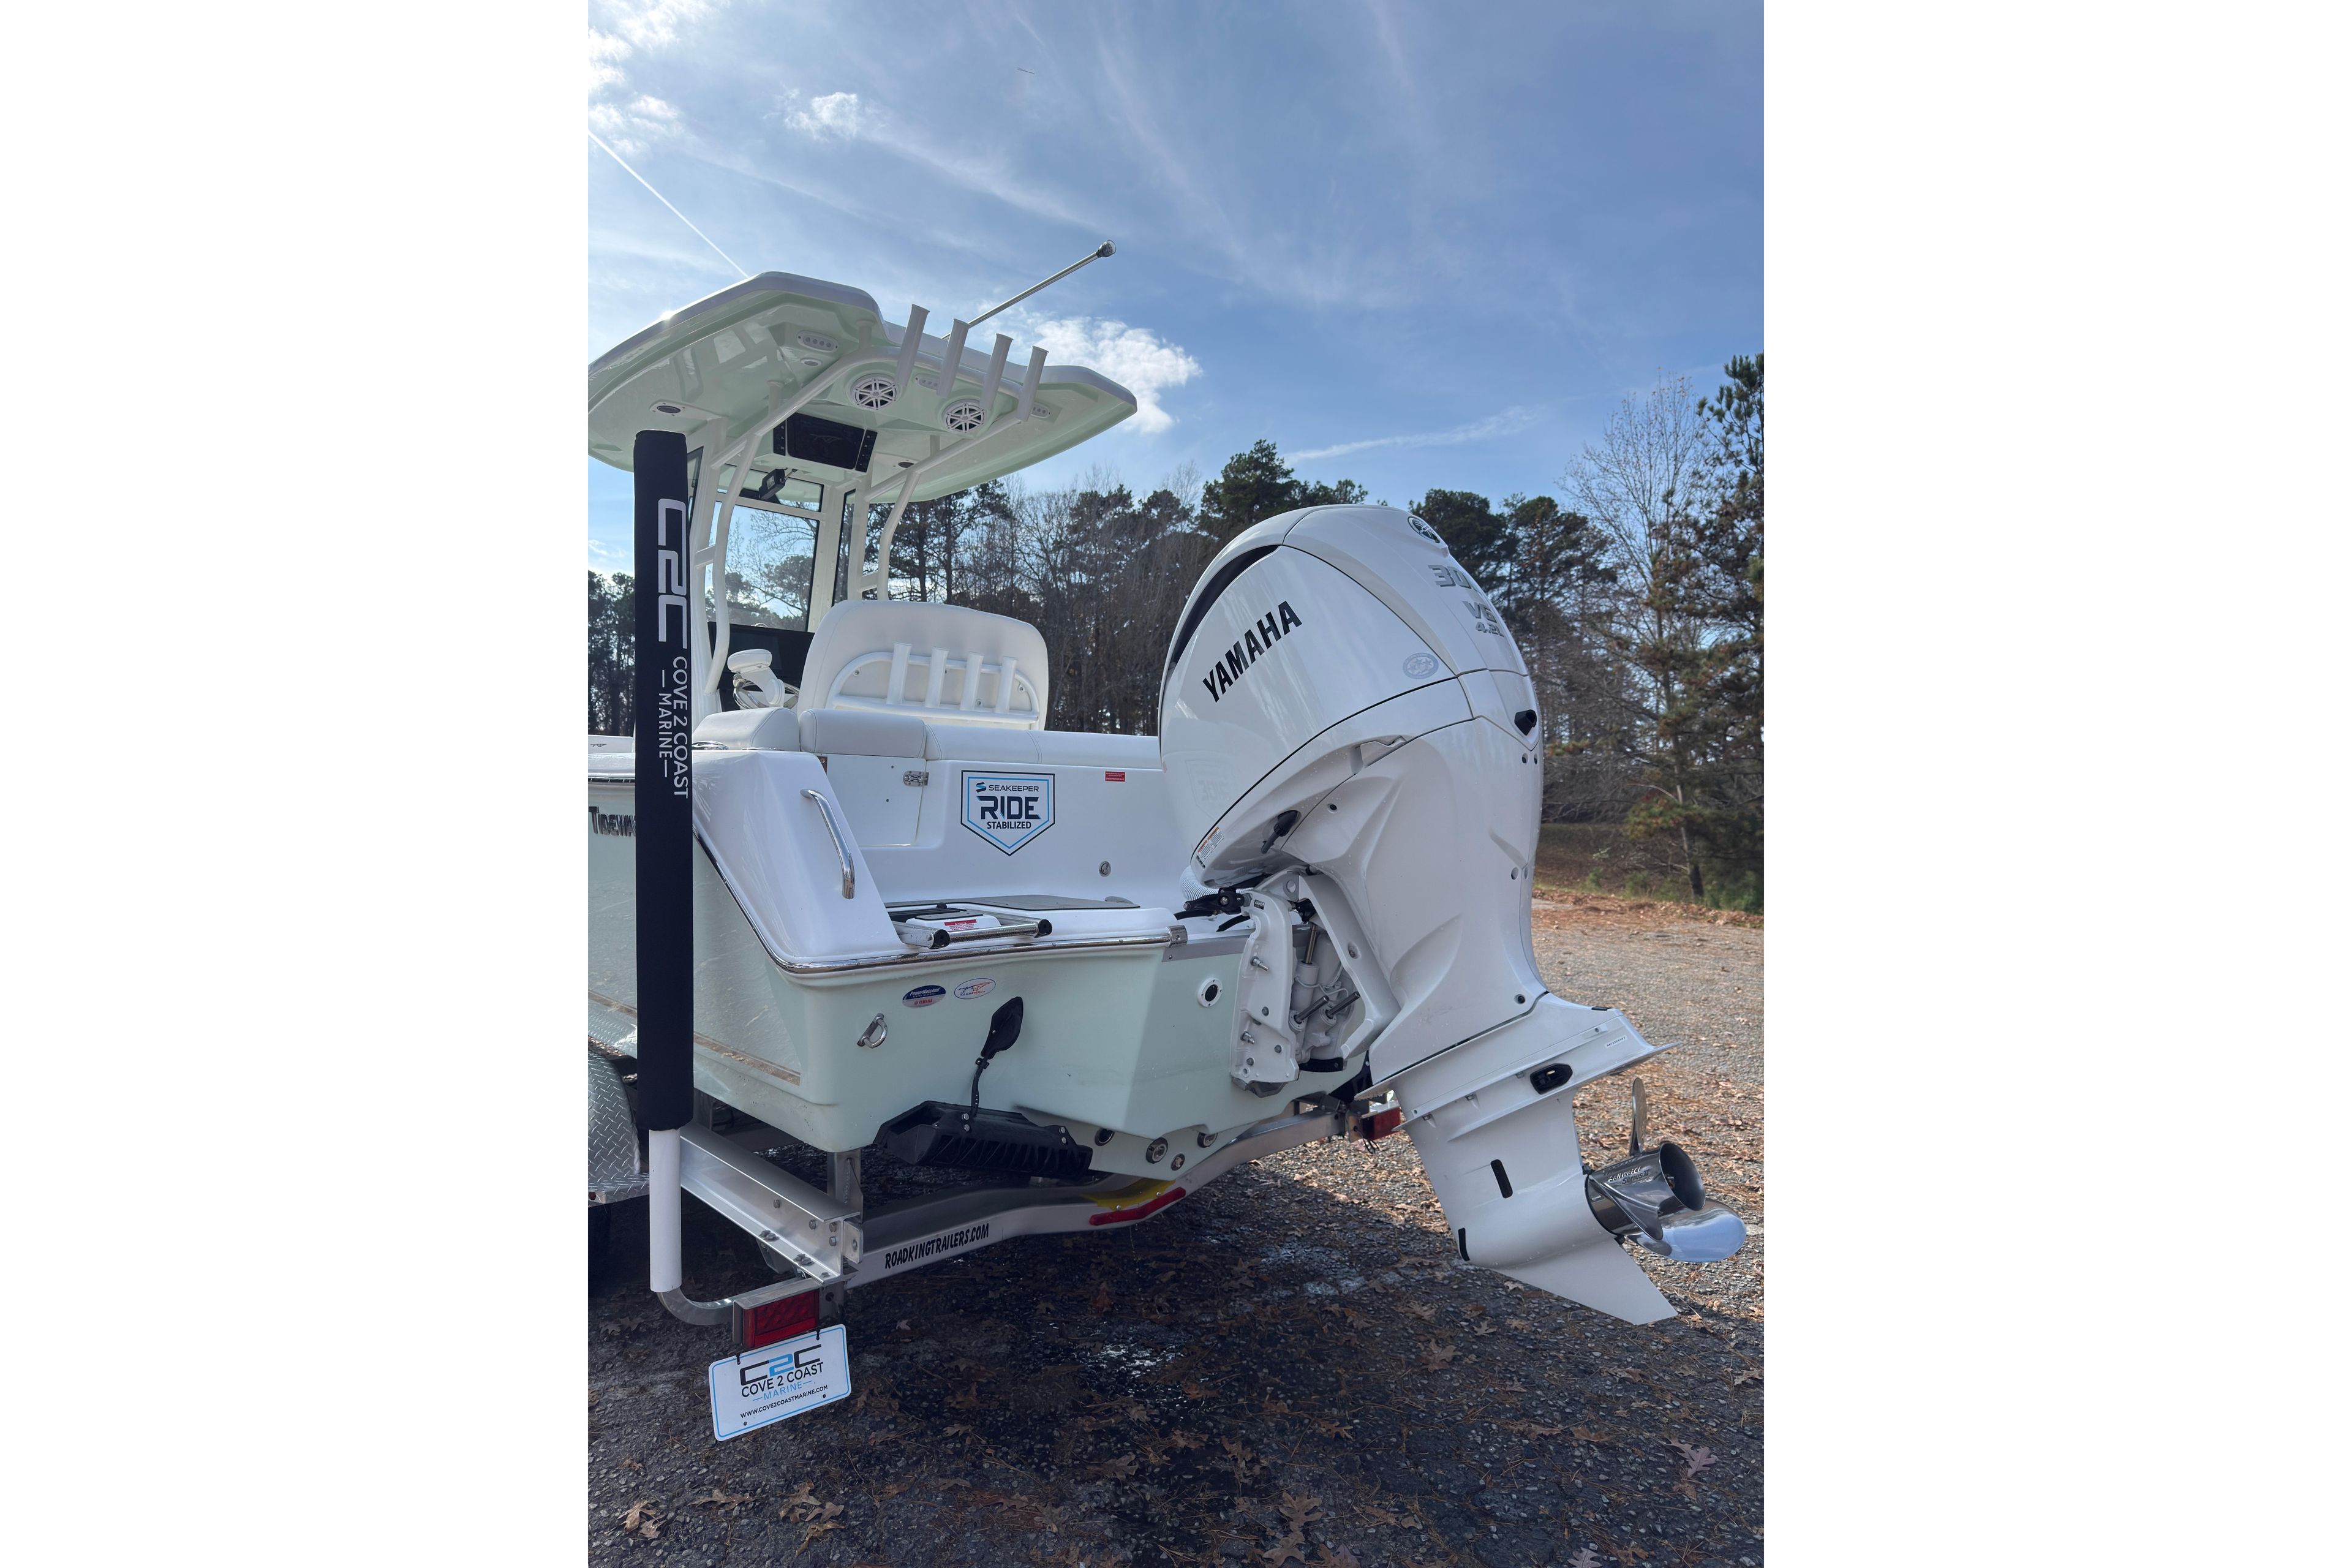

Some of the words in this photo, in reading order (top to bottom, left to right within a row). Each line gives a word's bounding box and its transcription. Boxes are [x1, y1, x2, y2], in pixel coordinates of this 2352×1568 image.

[658, 498, 687, 649] C2C
[1428, 565, 1479, 592] 30
[1462, 600, 1497, 624] V6
[1202, 600, 1303, 703] YAMAHA
[673, 656, 688, 710] COVE
[658, 693, 673, 758] MARINE
[673, 715, 688, 726] 2
[673, 732, 689, 799] COAST
[588, 806, 636, 837] TIDEWA
[976, 796, 1041, 820] RIDE
[987, 821, 1032, 829] STABILIZED
[885, 1223, 989, 1269] ROADKINGTRAILERS.COM
[739, 1344, 822, 1386] C2C
[741, 1378, 774, 1398] COVE
[777, 1376, 784, 1387] 2
[786, 1362, 824, 1383] COAST
[740, 1384, 828, 1419] WWW.COVE2COASTMARINE.COM
[763, 1382, 802, 1400] MARINE
